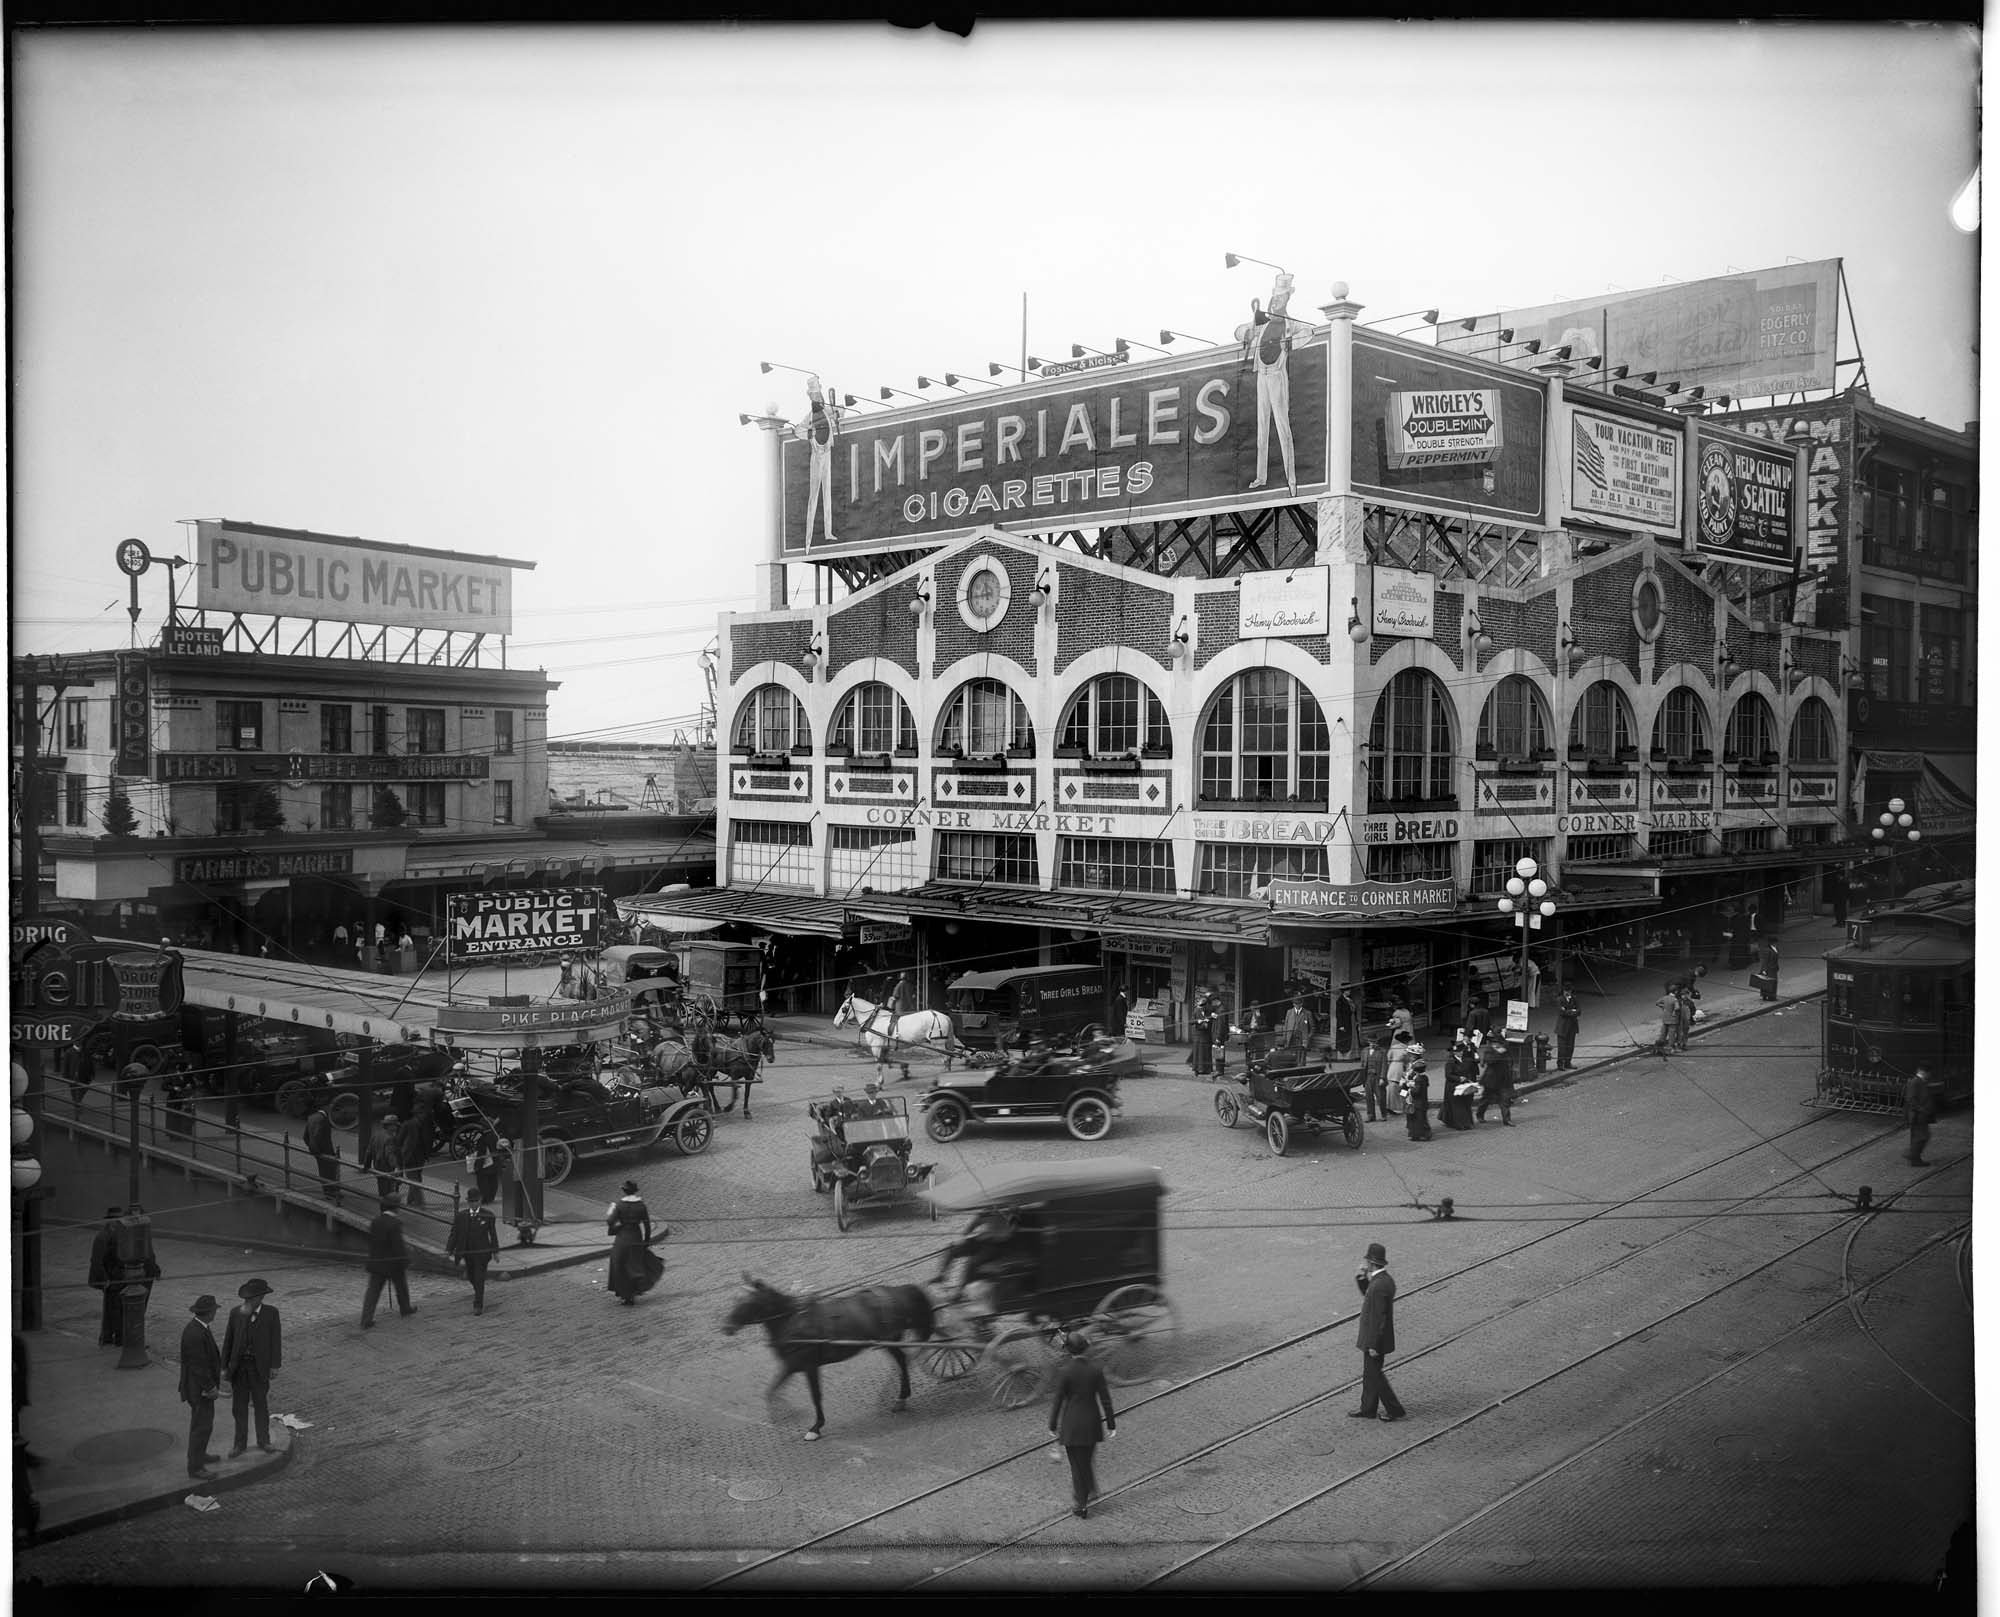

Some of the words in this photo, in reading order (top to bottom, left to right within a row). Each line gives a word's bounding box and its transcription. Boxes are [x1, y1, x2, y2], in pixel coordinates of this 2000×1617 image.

[1760, 312, 1812, 332] EDGERLY
[1760, 332, 1786, 349] FITZ
[1046, 364, 1078, 375] Foster
[1080, 361, 1086, 369] &
[1089, 353, 1125, 367] Kleiser
[1412, 392, 1483, 414] WRIGLEY'S
[1409, 417, 1488, 434] DOUBLEMINT
[850, 379, 1231, 502] IMPERIALES
[1417, 439, 1445, 449] DOUBLE
[1448, 437, 1484, 448] STRENGTH
[1595, 422, 1614, 442] YOUR
[1618, 429, 1653, 451] VACATION
[1657, 439, 1673, 456] FREE
[1407, 450, 1488, 465] PEPPERMINT
[1703, 453, 1724, 477] CLEAN
[1724, 462, 1734, 480] UP
[1621, 457, 1637, 472] FIRST
[1640, 461, 1669, 479] BATTALION
[1626, 471, 1641, 482] SECOND
[1735, 454, 1755, 480] HELP
[1756, 460, 1782, 489] CLEAN
[1782, 465, 1792, 490] UP
[903, 461, 1154, 523] CIGARETTES
[1591, 489, 1599, 498] CO.
[1609, 492, 1617, 501] CO.
[1613, 479, 1630, 490] NATIONAL
[1631, 482, 1645, 494] GUARD
[1645, 486, 1650, 494] OF
[1650, 487, 1672, 499] WASHINGTON
[1741, 483, 1786, 517] SEATTLE
[1807, 418, 1842, 582] MARKET
[1700, 488, 1709, 519] AND
[1708, 518, 1728, 534] PAINT
[1728, 497, 1735, 520] UP
[210, 538, 350, 601] PUBLIC
[362, 557, 502, 616] MARKET
[1244, 612, 1273, 630] Henry
[1272, 610, 1315, 627] Broderick
[1377, 609, 1397, 629] Henry
[1397, 608, 1427, 628] Broderick
[174, 630, 218, 643] HOTEL
[169, 643, 221, 656] LELAND
[123, 655, 145, 761] FOODS
[165, 756, 238, 778] FRESH
[866, 808, 971, 828] CORNER
[992, 812, 1116, 834] MARKET
[1193, 818, 1226, 830] THREE
[1363, 821, 1389, 833] THREE
[1364, 832, 1389, 843] GIRLS
[1394, 819, 1459, 840] BREAD
[1557, 815, 1636, 833] CORNER
[1651, 811, 1722, 830] MARKET
[1194, 828, 1226, 839] GIRLS
[1232, 820, 1336, 843] BREAD
[179, 855, 272, 882] FARMERS
[278, 854, 349, 876] MARKET
[478, 895, 573, 913] PUBLIC
[1275, 889, 1347, 906] ENTRANCE
[1349, 894, 1358, 905] TO
[1361, 890, 1410, 906] CORNER
[1413, 888, 1453, 905] MARKET
[456, 908, 596, 940] MARKET
[1851, 924, 1858, 940] 7
[13, 926, 68, 944] DRUG
[466, 934, 584, 954] ENTRANCE
[12, 959, 105, 1007] tell
[120, 970, 158, 984] DRUG
[120, 986, 160, 998] STORE
[1040, 990, 1060, 1001] THREE
[1060, 987, 1080, 998] GIRLS
[500, 1012, 541, 1024] PIKE
[12, 1023, 73, 1041] STORE
